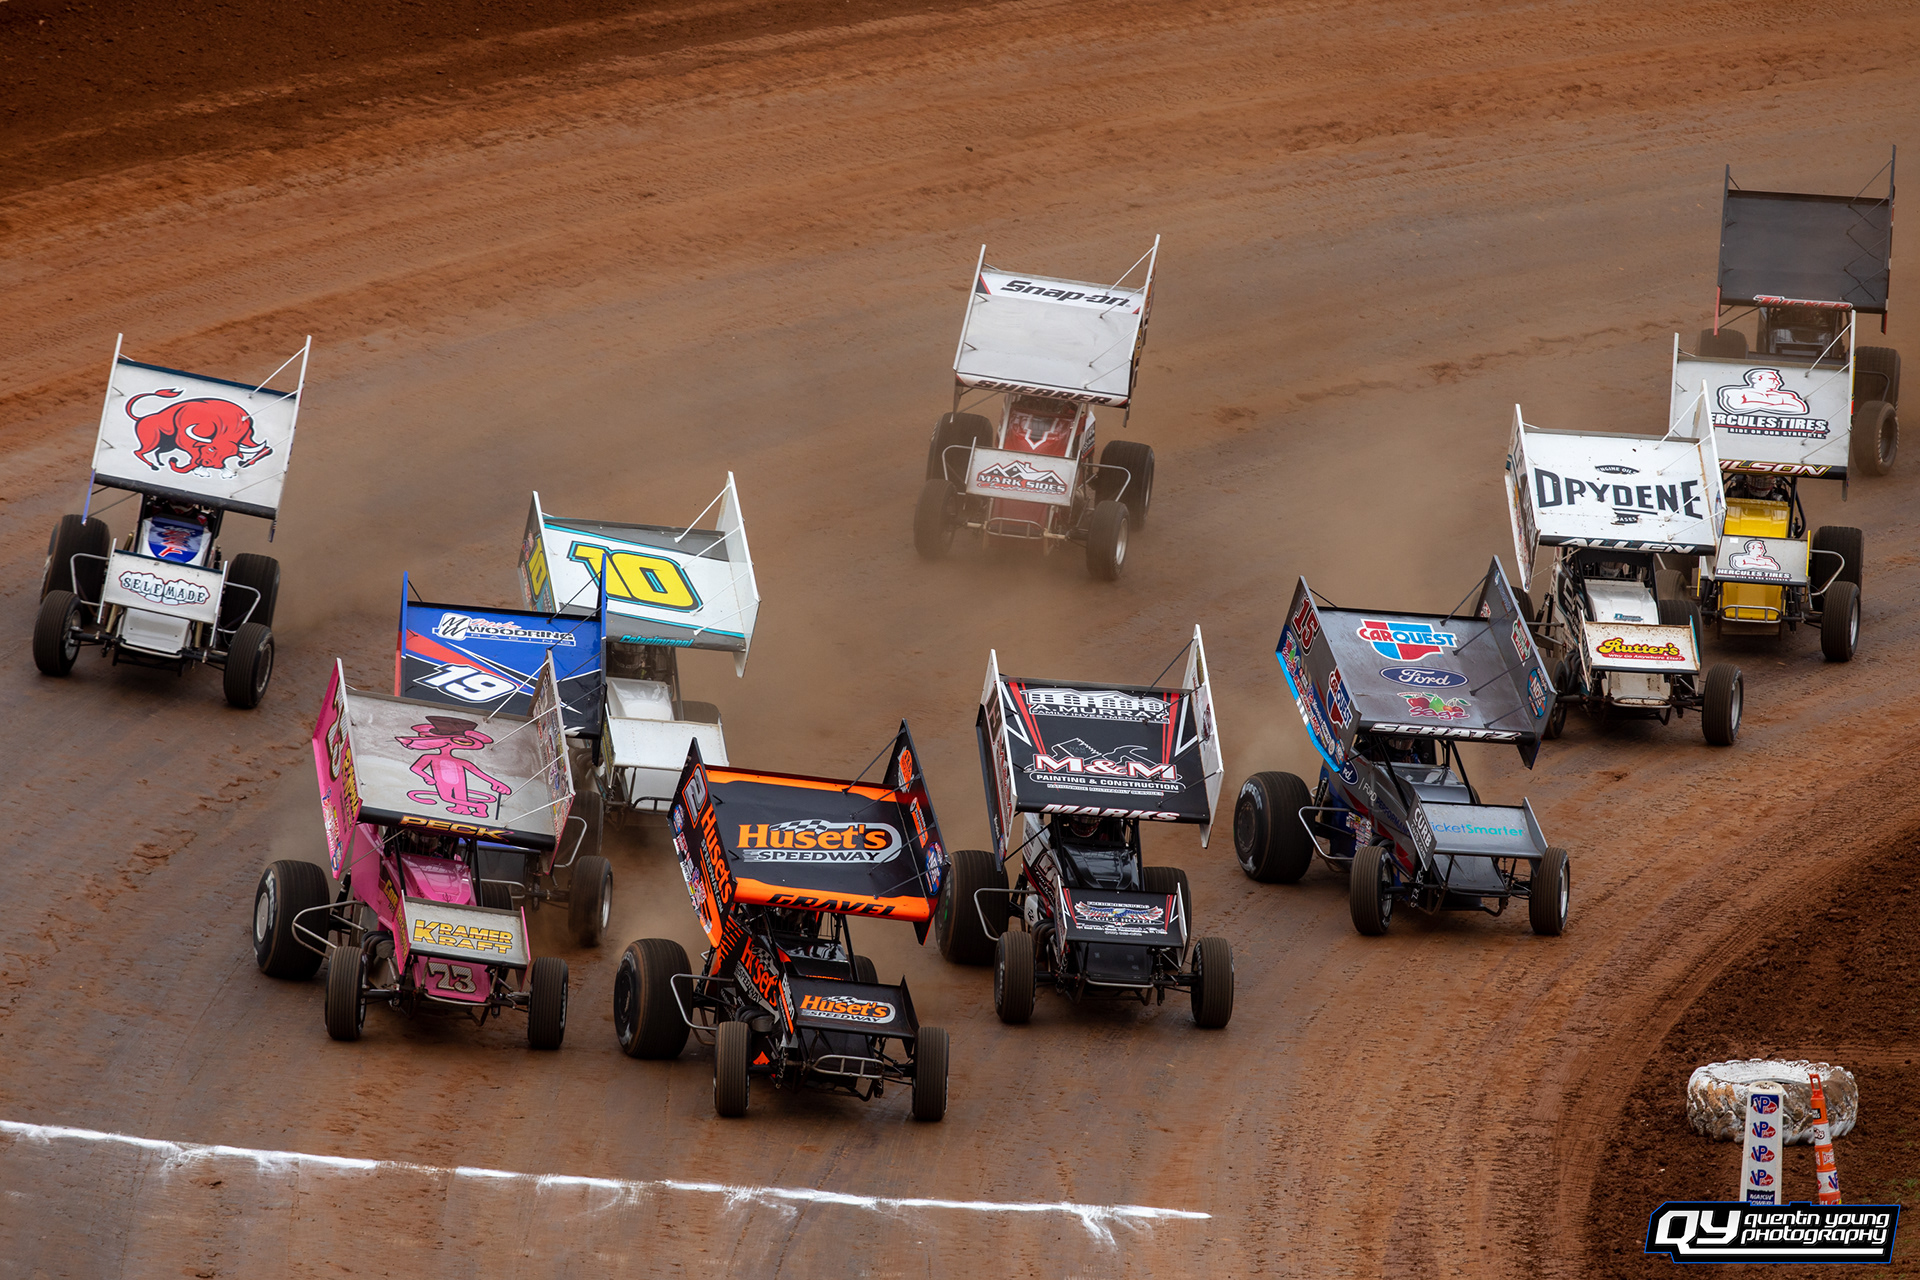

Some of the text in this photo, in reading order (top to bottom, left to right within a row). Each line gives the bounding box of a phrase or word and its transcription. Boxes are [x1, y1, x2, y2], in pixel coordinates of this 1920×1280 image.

[1000, 280, 1130, 307] Snap-on
[1755, 294, 1853, 310] TUCKER
[974, 379, 1112, 405] SHEARER
[1711, 413, 1826, 432] ERCULES TIRES
[1719, 460, 1829, 476] ILSON
[979, 475, 1022, 487] MARK
[1026, 481, 1065, 492] SIDES
[1534, 467, 1703, 520] DRYDENE
[1558, 537, 1699, 553] ALLEN
[571, 542, 702, 611] 10
[1717, 569, 1762, 577] HERCULES
[1765, 571, 1790, 579] TIRES
[123, 575, 205, 603] SELF MADE
[467, 625, 573, 641] WOODRING
[1292, 597, 1321, 652] 15
[1359, 627, 1456, 647] CARQUEST
[1598, 638, 1679, 656] Rutter's
[424, 664, 516, 701] 19
[1398, 669, 1451, 686] Ford
[1371, 723, 1521, 740] SCHATZ
[1034, 754, 1177, 780] M&M
[1037, 774, 1086, 783] PAINTING
[1100, 779, 1179, 790] CONSTRUCTION
[683, 765, 707, 823] 2
[1040, 803, 1180, 821] MARKS
[400, 815, 508, 840] PECK
[737, 823, 887, 850] Huset's
[1414, 807, 1432, 848] CURB
[757, 851, 880, 862] SPEEDWAY
[766, 893, 896, 917] GRAVEL
[413, 919, 512, 944] KRAMER
[426, 961, 477, 994] 73
[800, 994, 888, 1017] Huset's
[810, 1012, 881, 1023] SPEEDWAY
[1753, 1097, 1770, 1114] VP
[1753, 1121, 1769, 1138] VP
[1752, 1145, 1768, 1162] VP
[1751, 1169, 1767, 1186] VP
